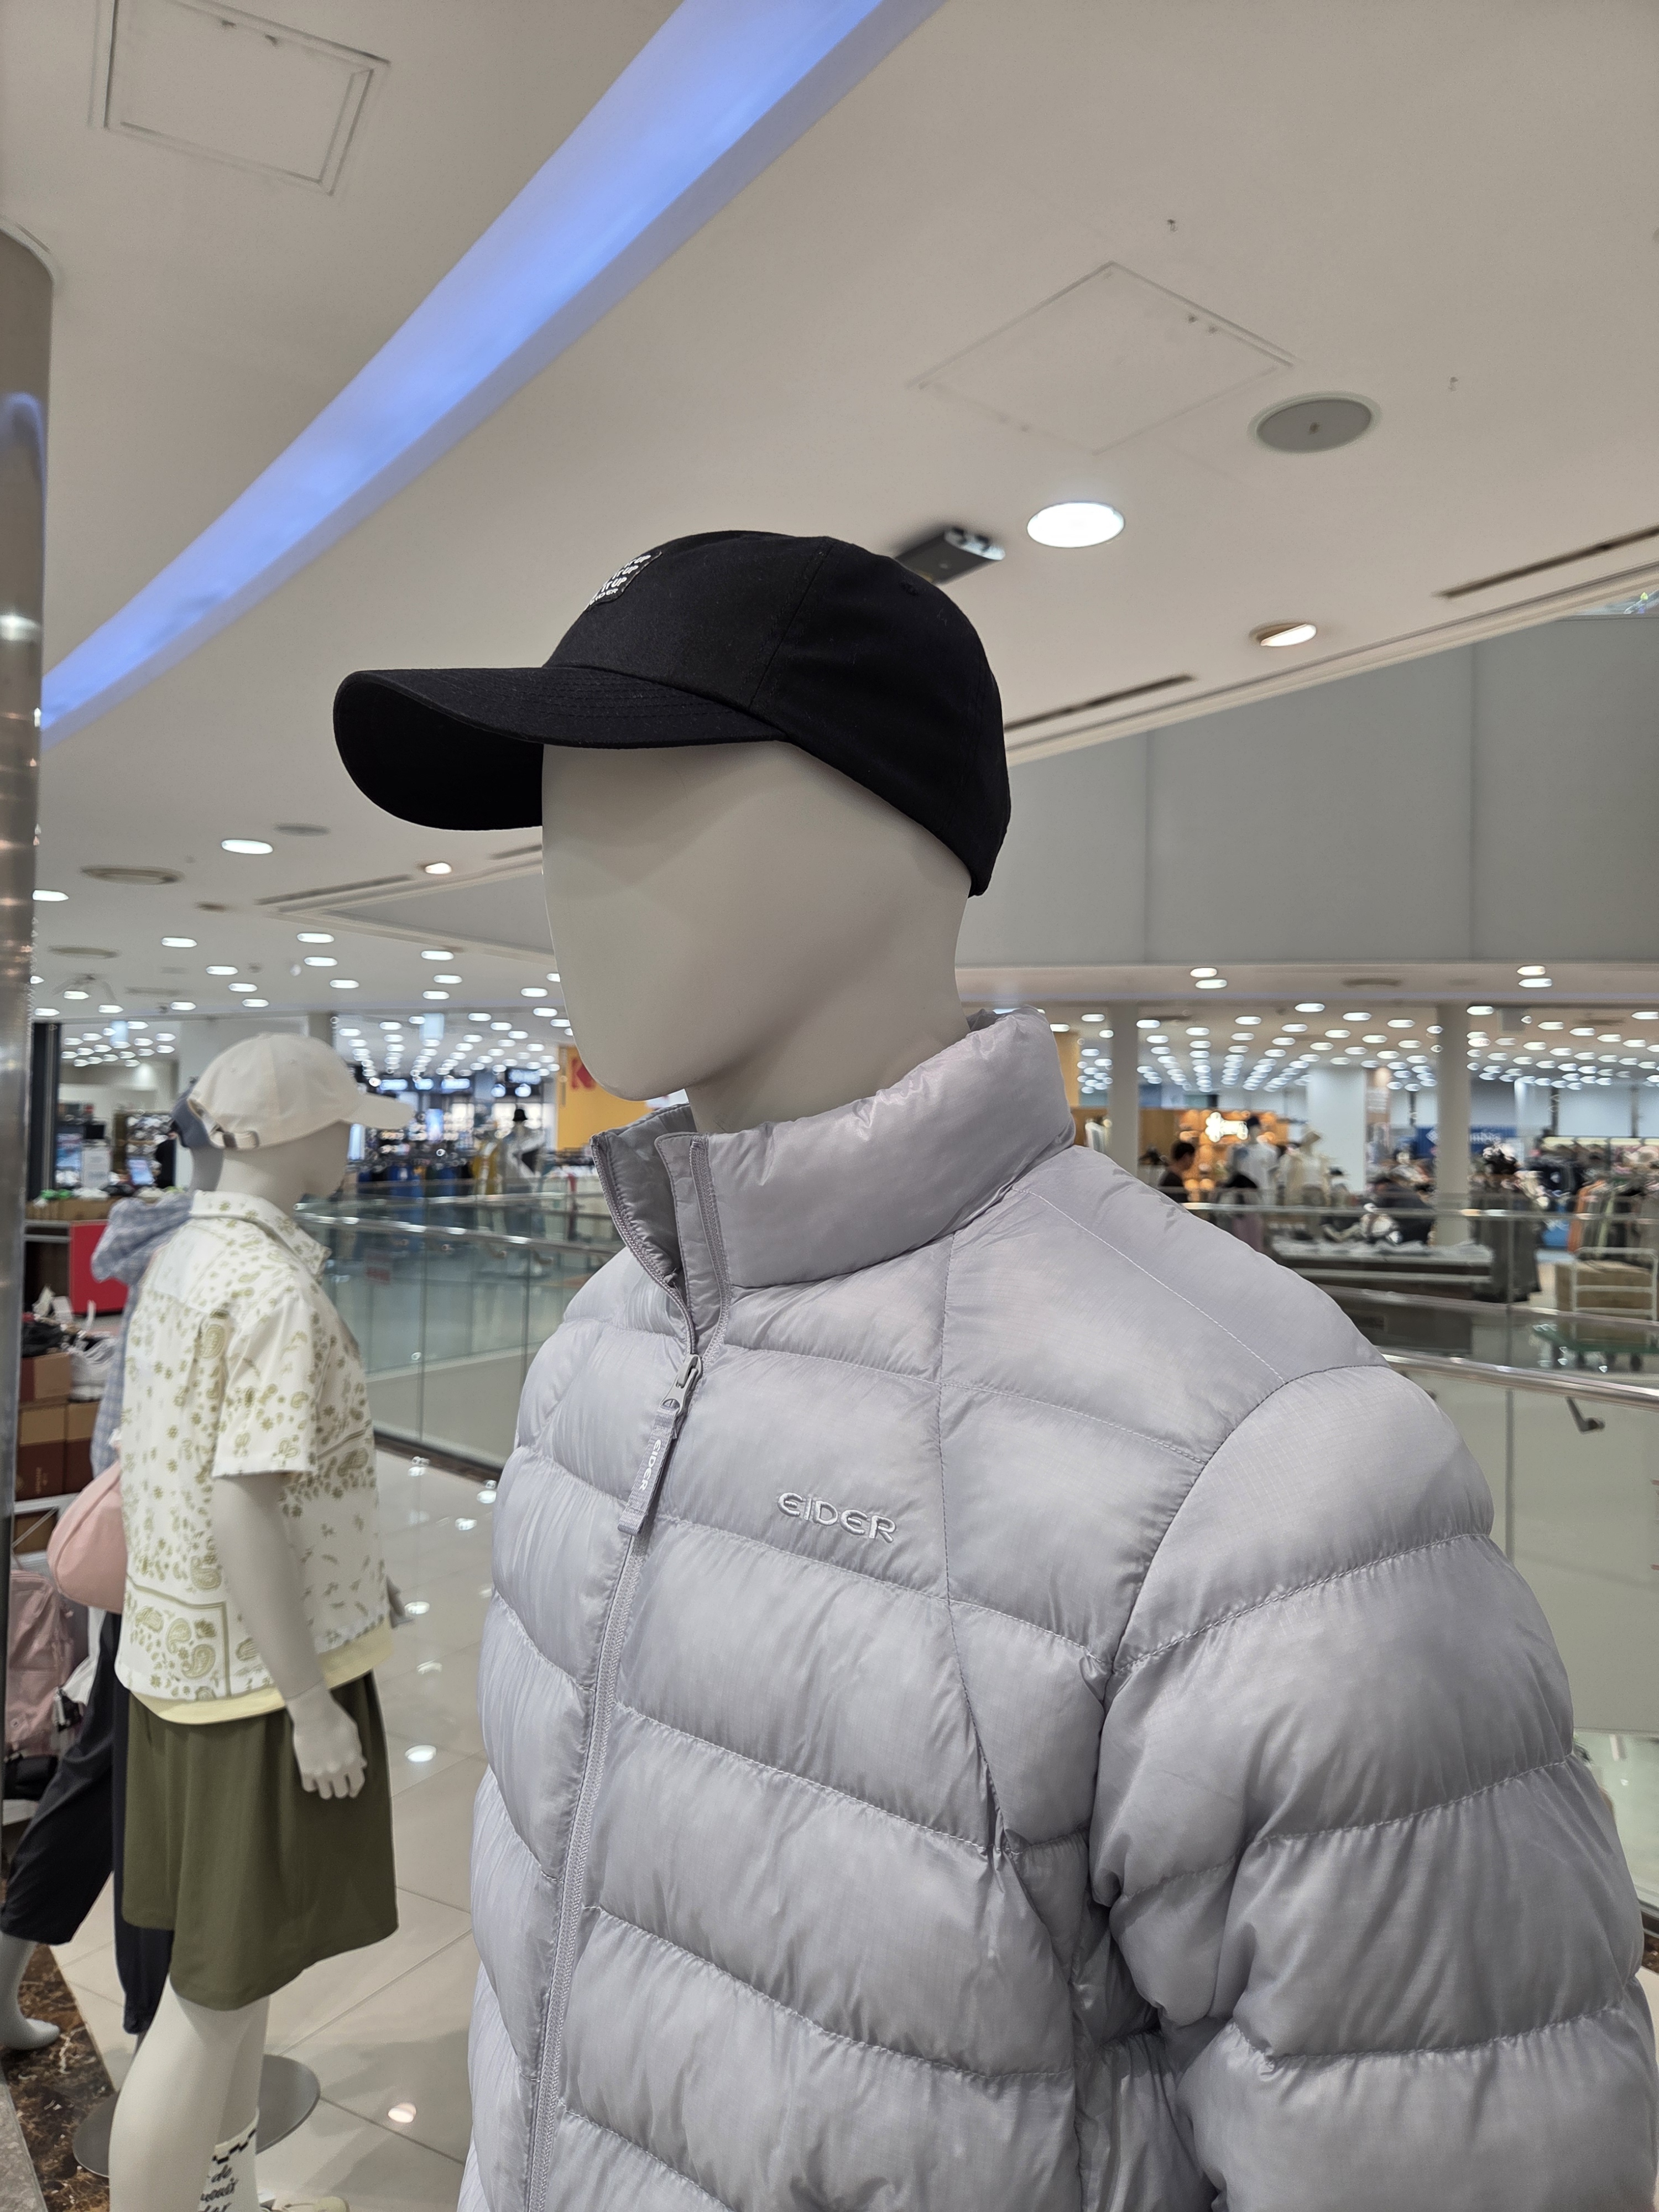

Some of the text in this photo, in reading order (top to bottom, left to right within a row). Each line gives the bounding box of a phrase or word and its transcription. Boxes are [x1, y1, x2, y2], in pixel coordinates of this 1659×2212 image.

[611, 577, 627, 588] UP
[622, 565, 639, 575] UP
[639, 1439, 662, 1491] EIDER
[777, 1492, 896, 1543] EIDER
